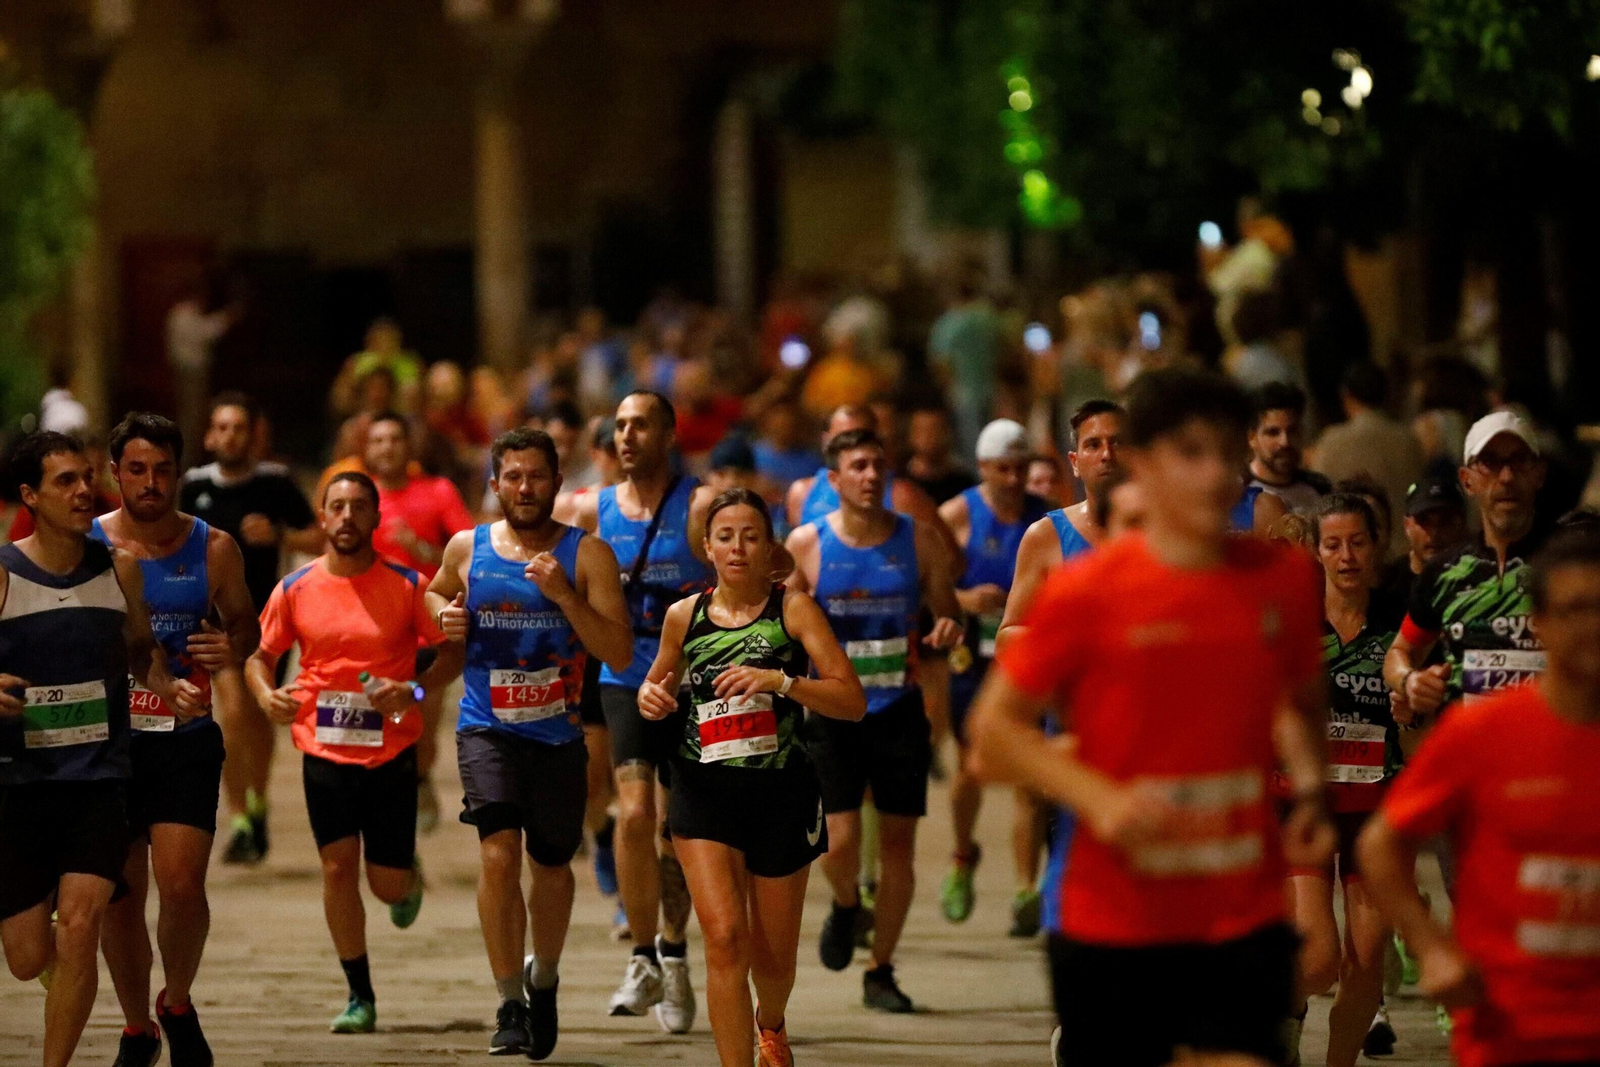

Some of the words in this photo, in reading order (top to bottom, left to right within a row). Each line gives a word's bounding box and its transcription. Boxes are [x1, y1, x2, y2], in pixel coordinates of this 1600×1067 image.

[477, 610, 495, 628] 20
[495, 611, 530, 619] CARRERA
[496, 618, 569, 629] TROTACALLES
[1489, 653, 1506, 666] 20
[512, 673, 525, 684] 20
[47, 689, 63, 702] 20
[506, 685, 550, 703] 1457
[49, 703, 85, 723] 576
[715, 702, 729, 716] 20
[332, 707, 365, 726] 875
[1330, 726, 1346, 738] 20
